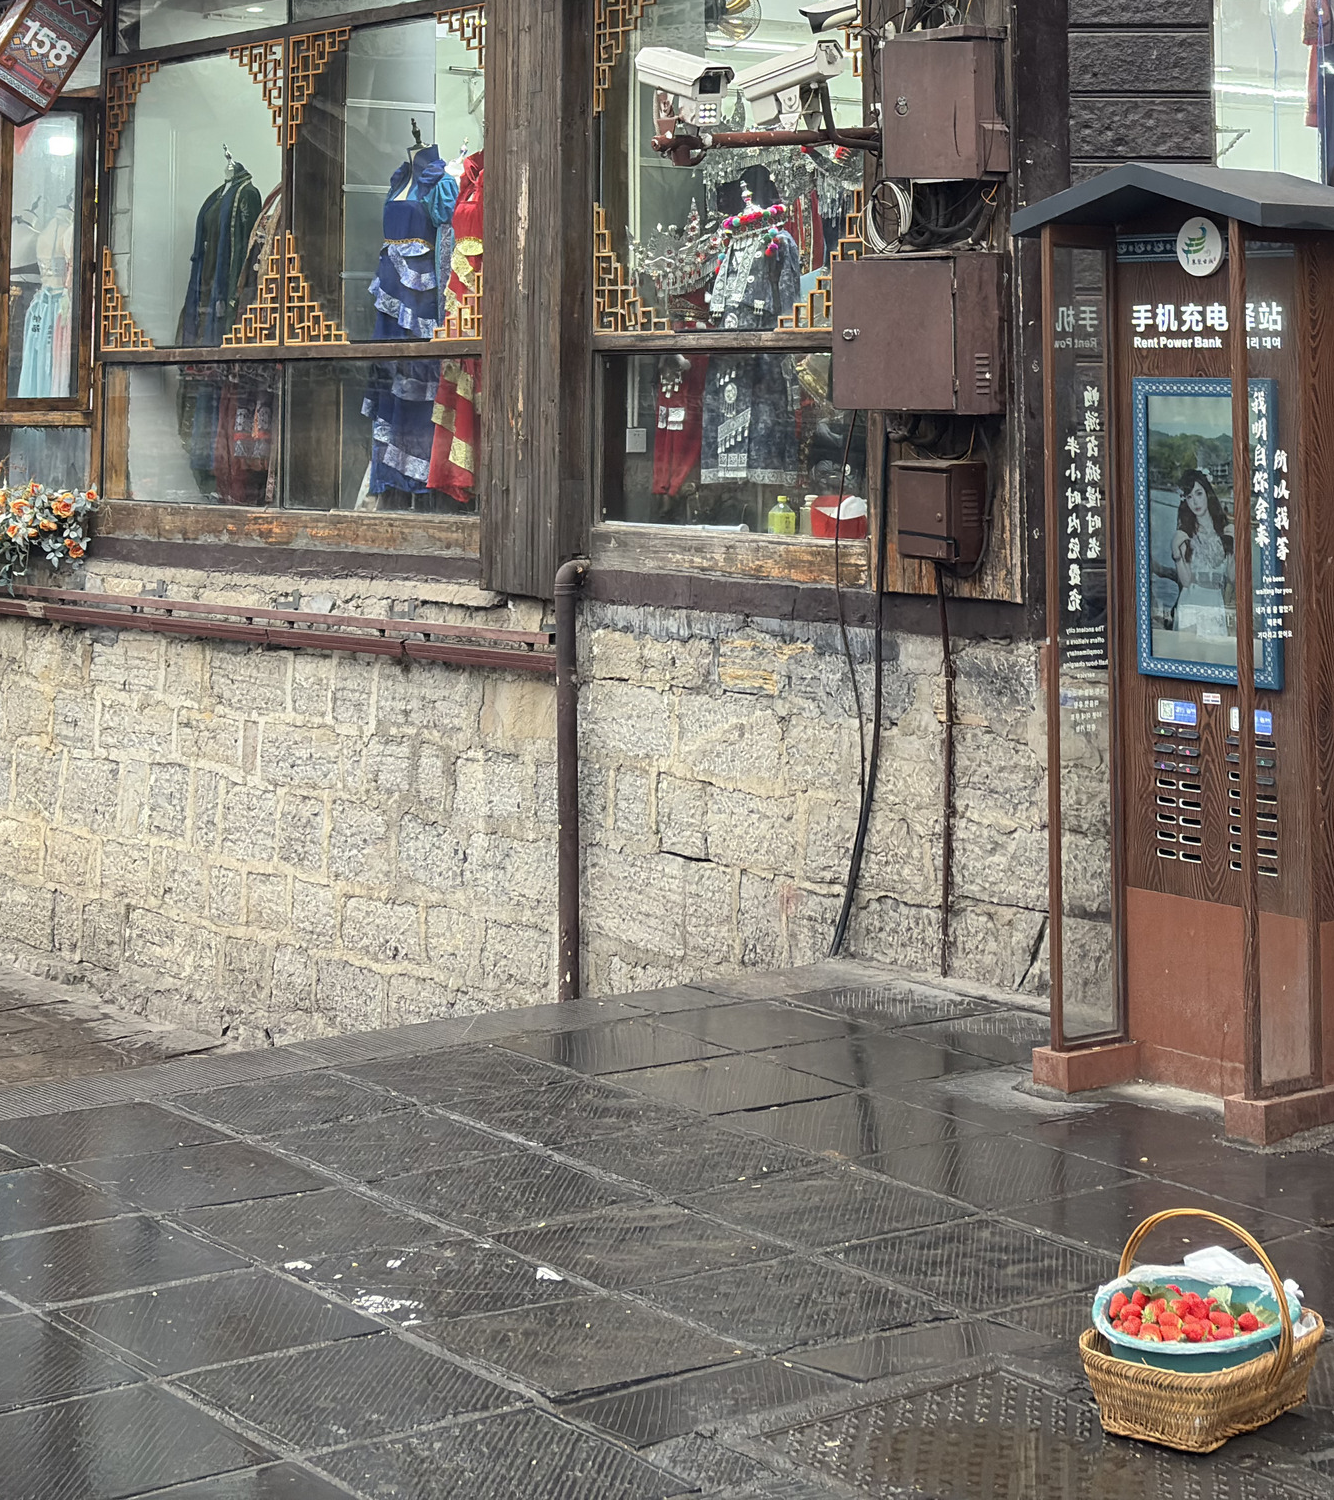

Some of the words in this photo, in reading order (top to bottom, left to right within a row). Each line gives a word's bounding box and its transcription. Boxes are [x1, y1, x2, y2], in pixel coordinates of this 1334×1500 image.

[23, 20, 72, 66] 158
[1133, 337, 1158, 349] Rent
[1160, 337, 1193, 349] Power
[1194, 337, 1222, 349] Bank
[1274, 449, 1290, 561] 所以我等
